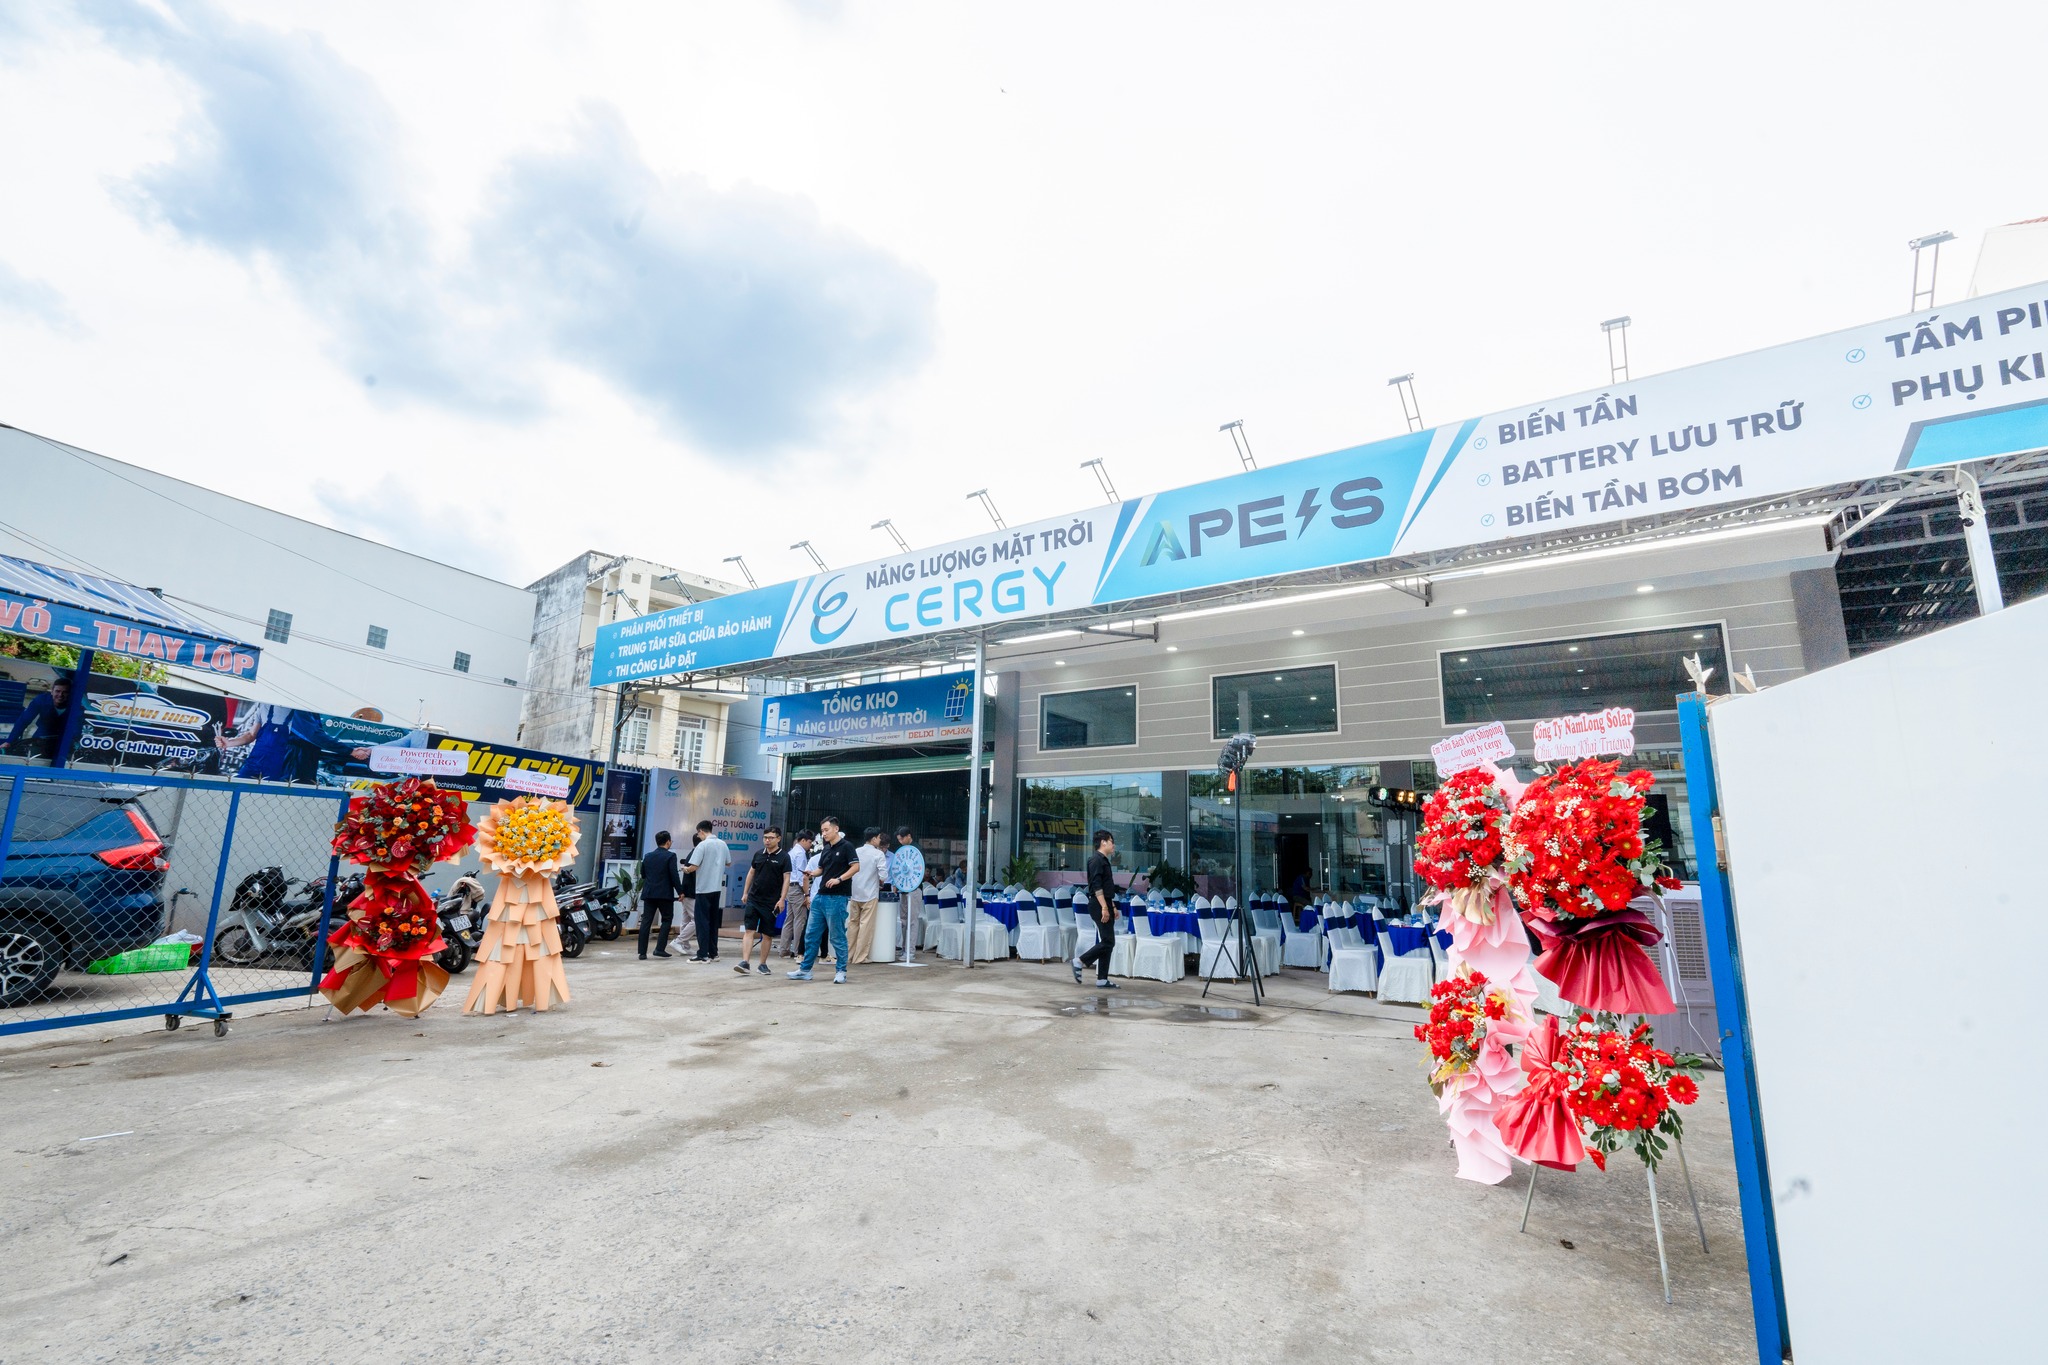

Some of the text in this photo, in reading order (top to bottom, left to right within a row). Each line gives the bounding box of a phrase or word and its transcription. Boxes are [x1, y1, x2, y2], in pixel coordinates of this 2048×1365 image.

[1885, 300, 2048, 358] TẤM PI
[1892, 364, 1984, 406] PHỤ
[1498, 392, 1638, 445] BIẾN TẦN
[1502, 400, 1805, 486] BATTERY LƯU TRỮ
[1506, 464, 1743, 527] BIẾN TẦN BƠM
[866, 518, 1093, 590] NĂNG LƯỢNG MẶT TRỜI
[884, 560, 1066, 633] CERGY
[619, 642, 646, 658] TRUNG
[649, 636, 667, 652] TÂM
[689, 626, 716, 644] CHỮA
[718, 620, 740, 638] BẢO
[742, 615, 772, 633] HÀNH
[620, 608, 703, 638] PHÂN PHỐI THIẾT BỊ
[94, 620, 185, 662] THAY
[192, 643, 254, 675] LỐP
[616, 650, 697, 677] THI CÔNG LẮP ĐẶT
[822, 691, 899, 715] TỔNG KHO
[796, 708, 927, 734] NĂNG LƯỢNG MẶT TRỜI
[908, 730, 934, 739] DELIXI
[1534, 711, 1632, 741] Công Ty NamLong Solar
[116, 740, 163, 756] CHÍNH
[400, 750, 443, 758] Powertech
[1433, 746, 1440, 755] Em
[1476, 725, 1503, 740] Shipping
[1484, 738, 1502, 750] Cergy
[424, 758, 458, 766] CERGY
[713, 807, 766, 820] NĂNG LƯỢNG
[740, 798, 759, 808] PHÁP
[712, 820, 728, 828] CHO
[730, 820, 754, 829] TƯƠNG
[718, 828, 758, 842] BỀN VỮNG
